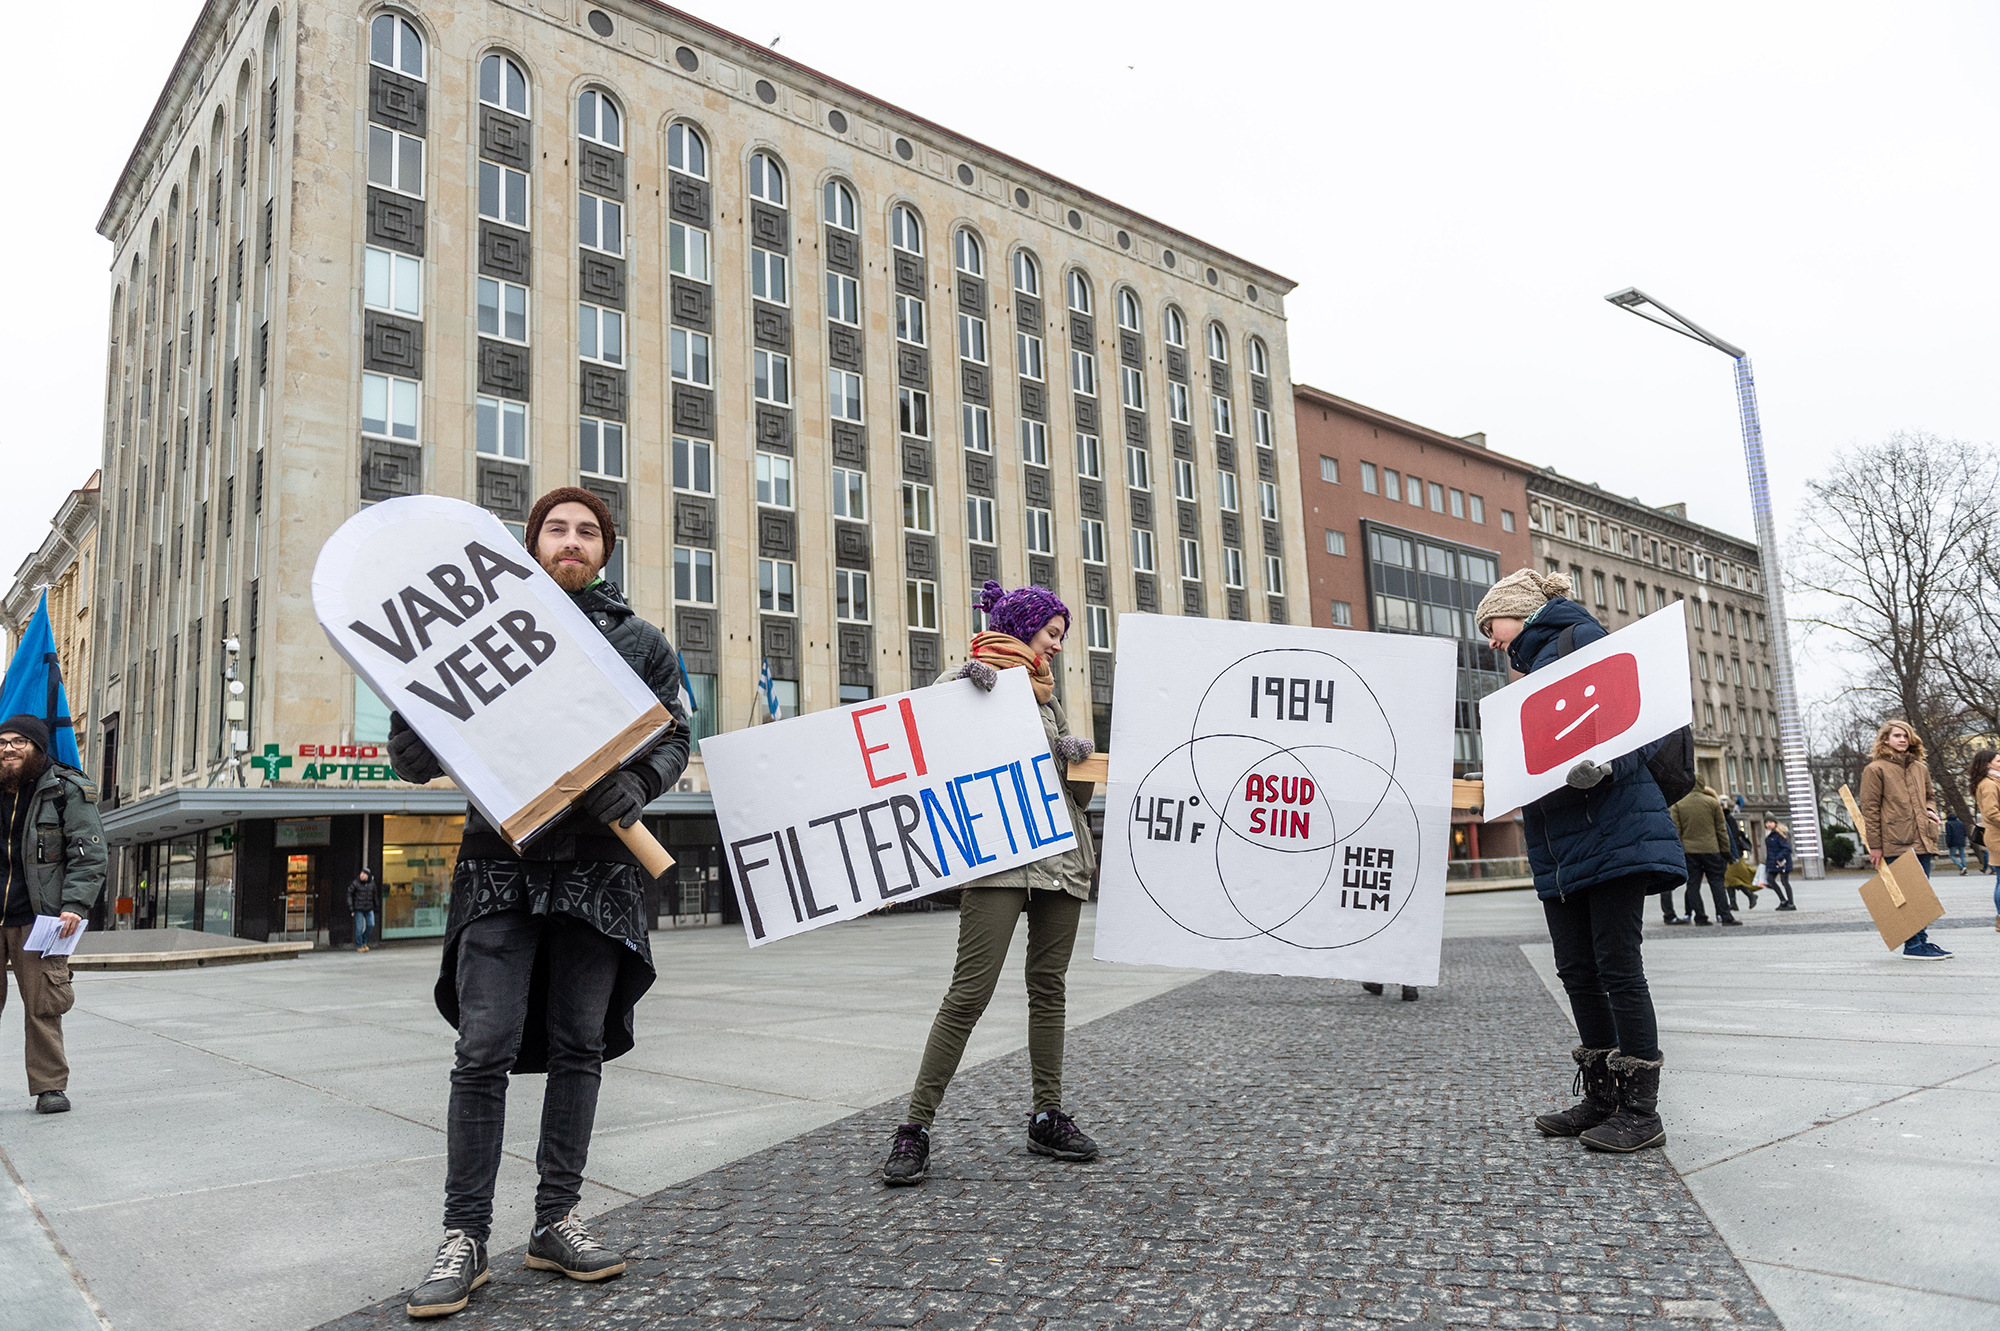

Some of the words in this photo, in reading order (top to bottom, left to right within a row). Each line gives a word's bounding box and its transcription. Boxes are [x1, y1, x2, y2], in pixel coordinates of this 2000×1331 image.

[349, 541, 534, 664] VABA
[405, 610, 557, 722] VEEB
[1250, 675, 1335, 723] 1984
[298, 744, 378, 758] EURO
[851, 698, 928, 788] EI
[302, 763, 401, 780] APTEEK
[1245, 773, 1315, 806] ASUD
[1249, 808, 1310, 839] SIIN
[730, 752, 1074, 940] FILTERNETILE
[1344, 846, 1394, 869] HEA
[1342, 868, 1392, 891] UUS
[1340, 889, 1390, 912] ILM
